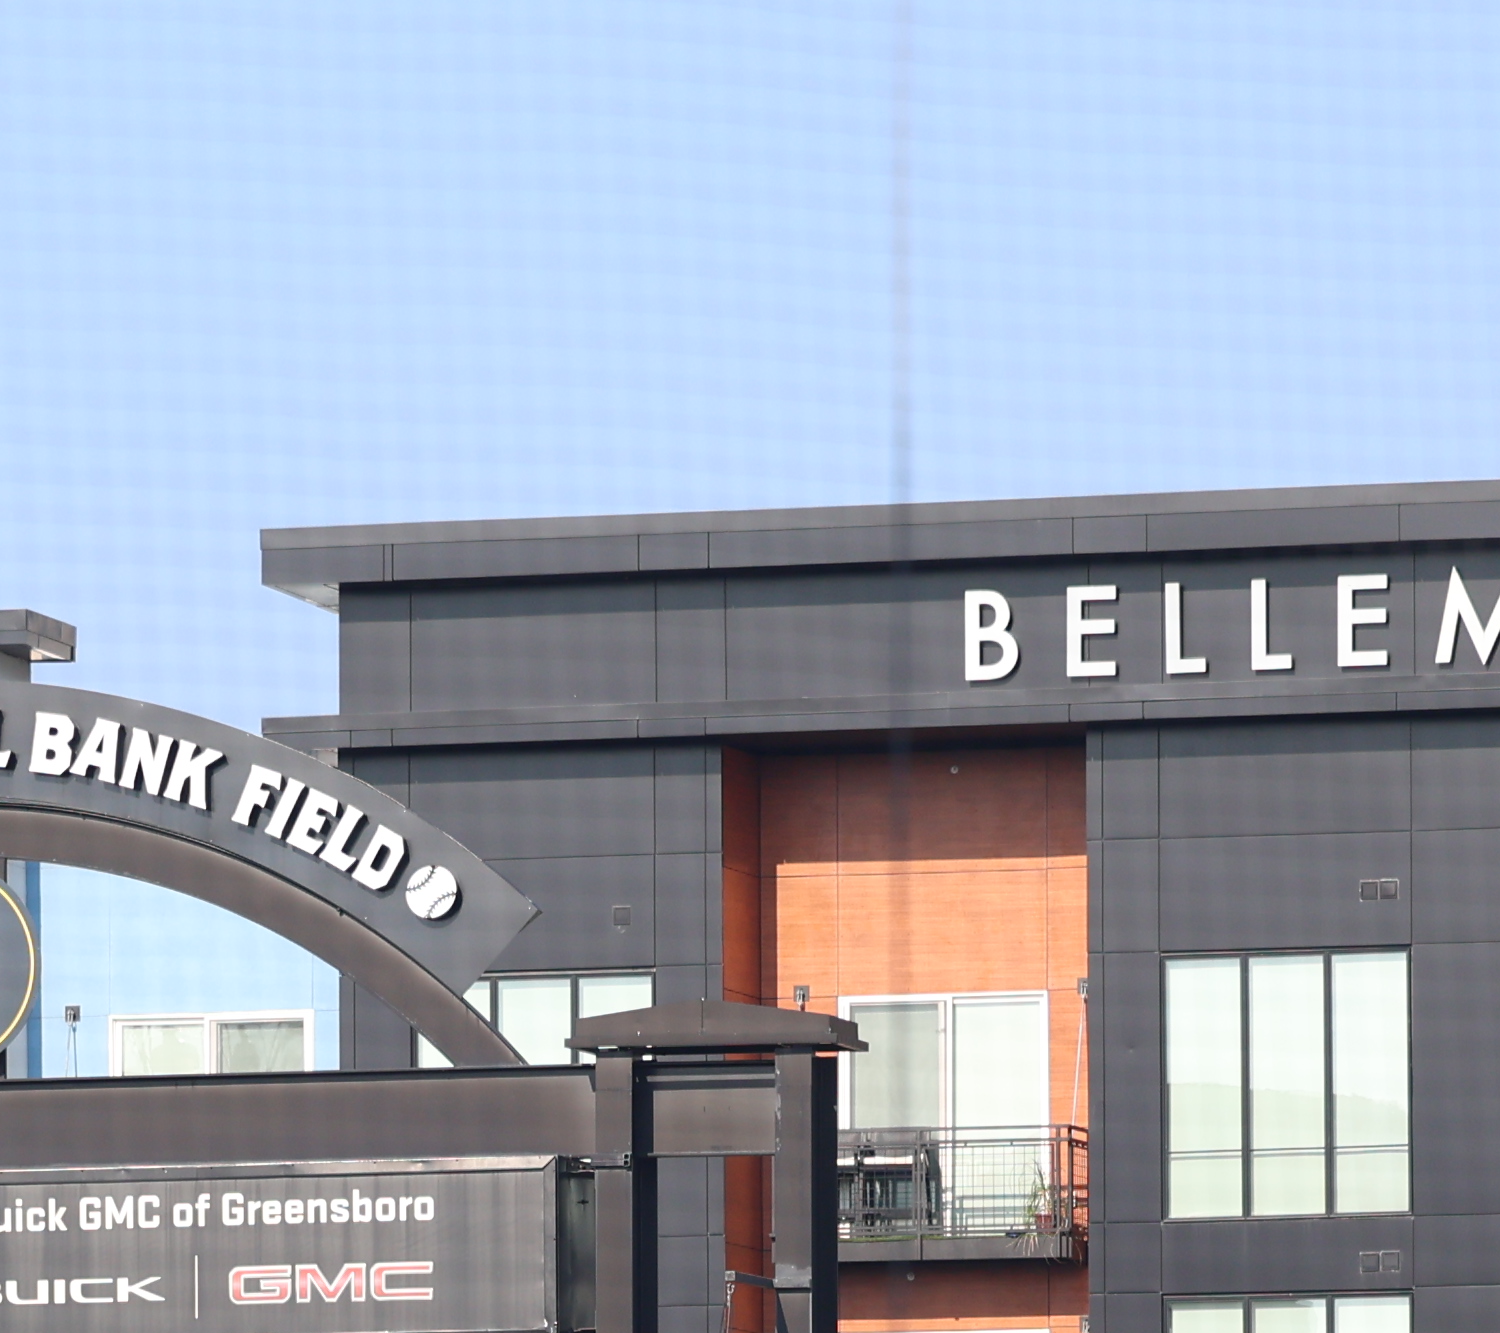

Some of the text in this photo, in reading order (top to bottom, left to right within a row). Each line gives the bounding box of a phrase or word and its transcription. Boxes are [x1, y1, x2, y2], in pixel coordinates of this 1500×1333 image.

[29, 711, 225, 809] BANK
[232, 763, 409, 890] FIELD
[79, 1195, 161, 1230] GMC
[173, 1193, 210, 1228] of
[221, 1189, 435, 1226] Greensboro
[229, 1261, 434, 1305] GMC
